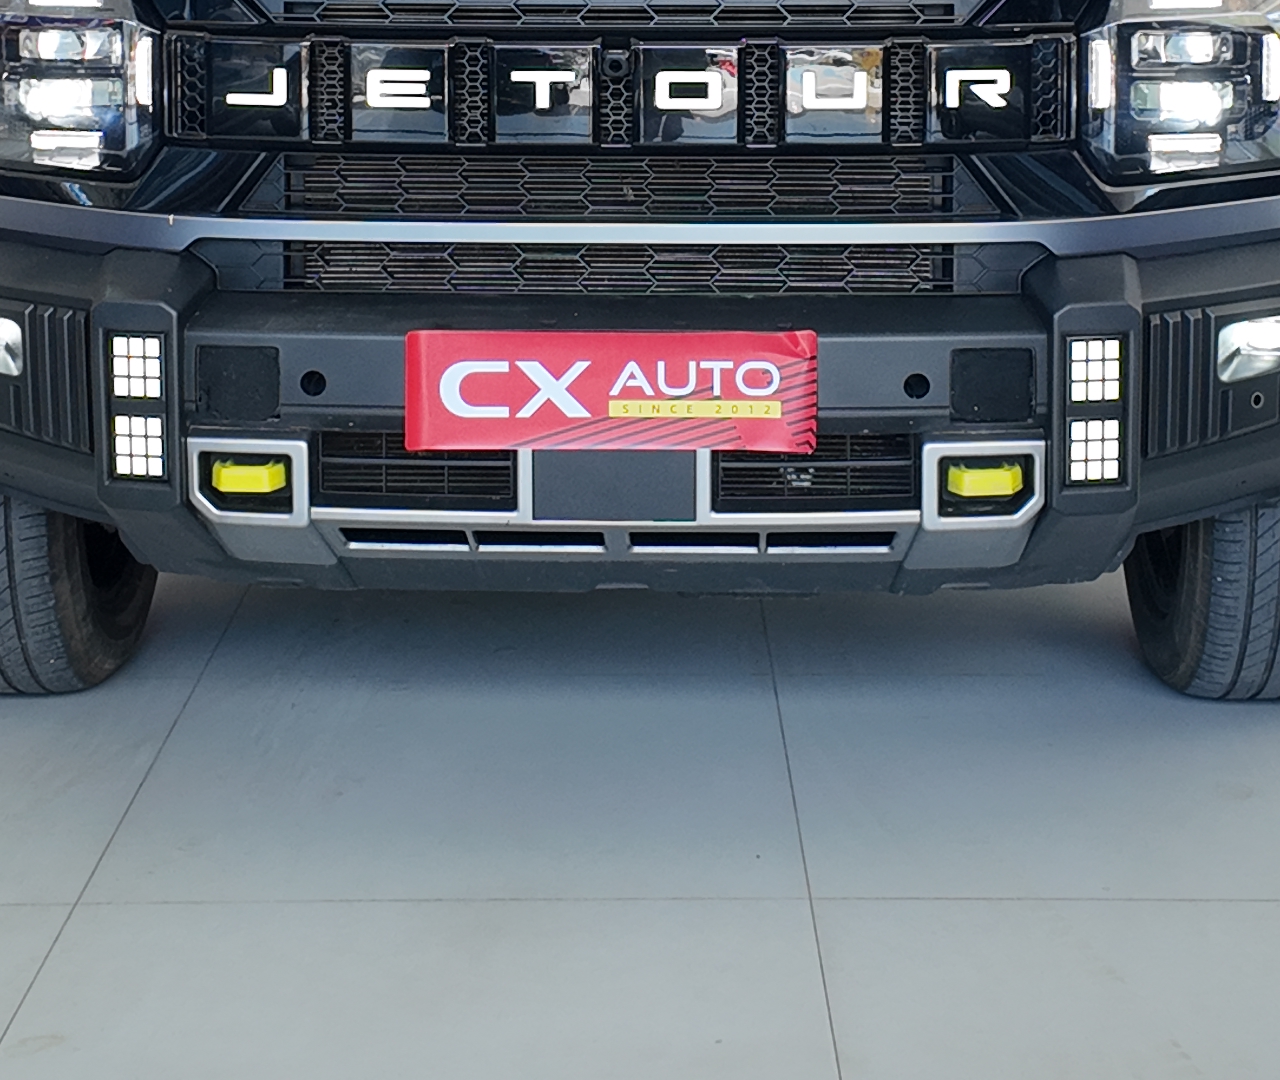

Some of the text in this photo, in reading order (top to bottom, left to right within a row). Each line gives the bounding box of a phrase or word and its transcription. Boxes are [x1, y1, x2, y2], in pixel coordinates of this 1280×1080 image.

[226, 67, 1011, 109] JETOUR
[439, 360, 781, 418] CX AUTO
[622, 404, 772, 414] SINCE 2012
